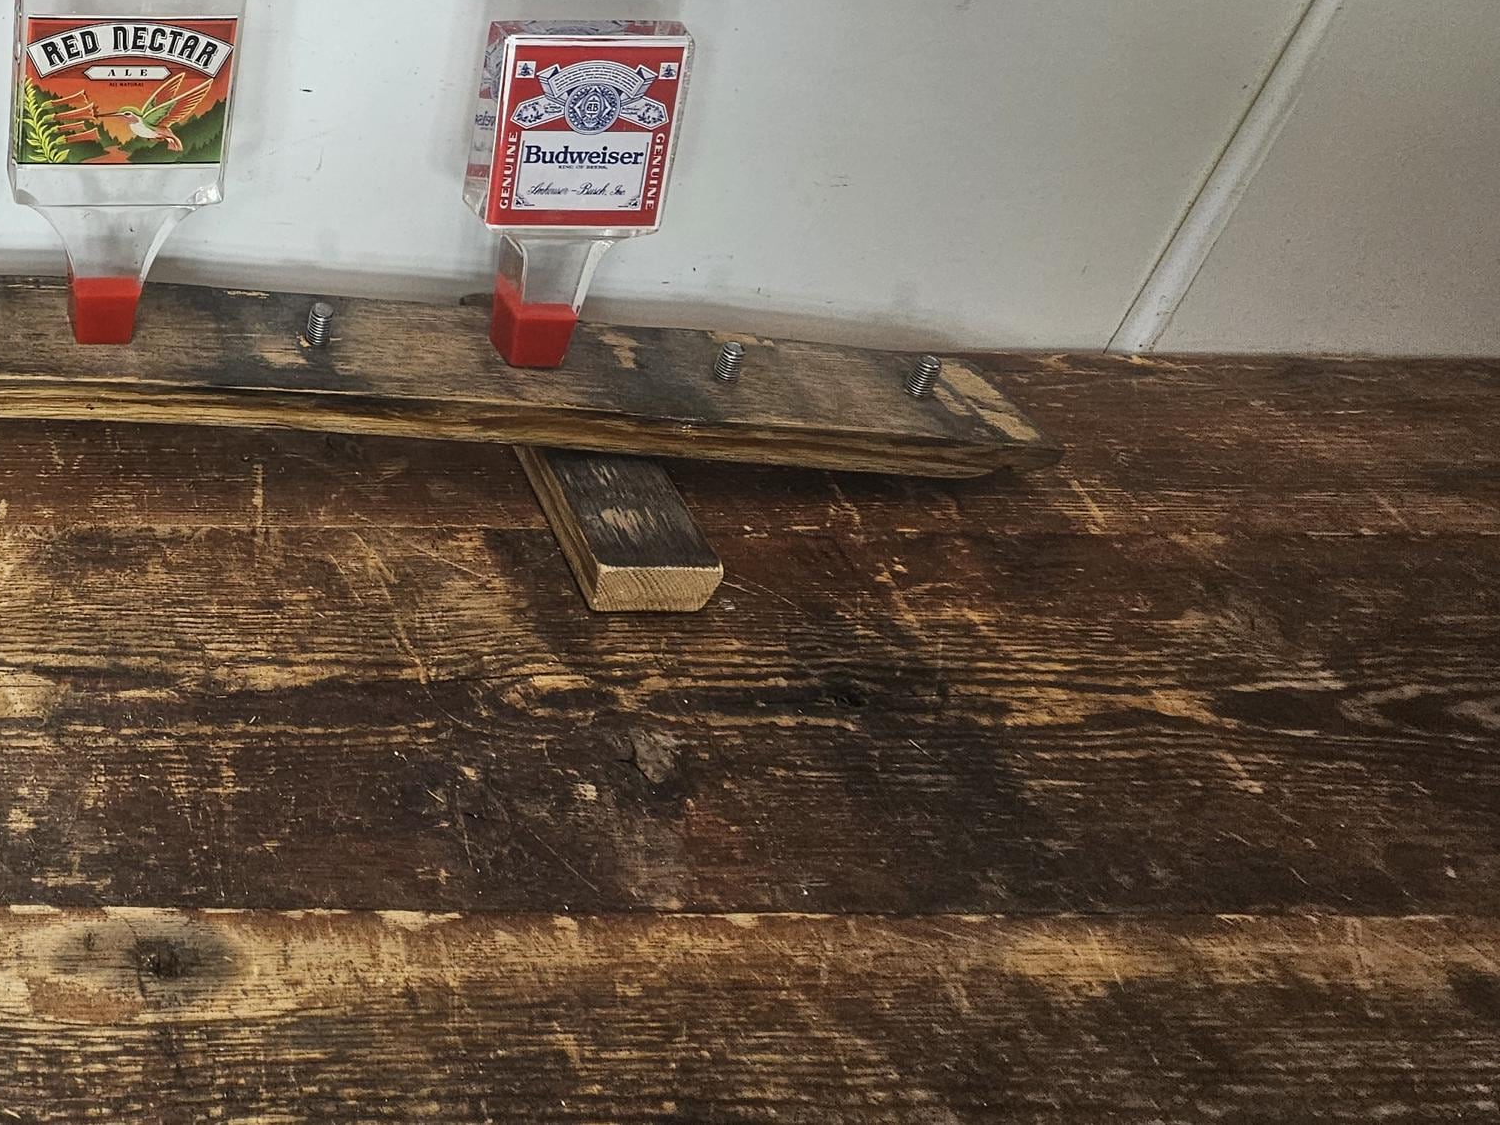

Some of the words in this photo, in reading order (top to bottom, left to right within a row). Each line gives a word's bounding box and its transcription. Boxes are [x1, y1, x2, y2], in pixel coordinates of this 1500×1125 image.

[41, 30, 102, 68] RED
[113, 26, 218, 69] NECTAR
[107, 69, 148, 77] ALE
[500, 131, 518, 209] GENUINE
[523, 145, 644, 165] Budweiser
[646, 133, 666, 210] GENUINE
